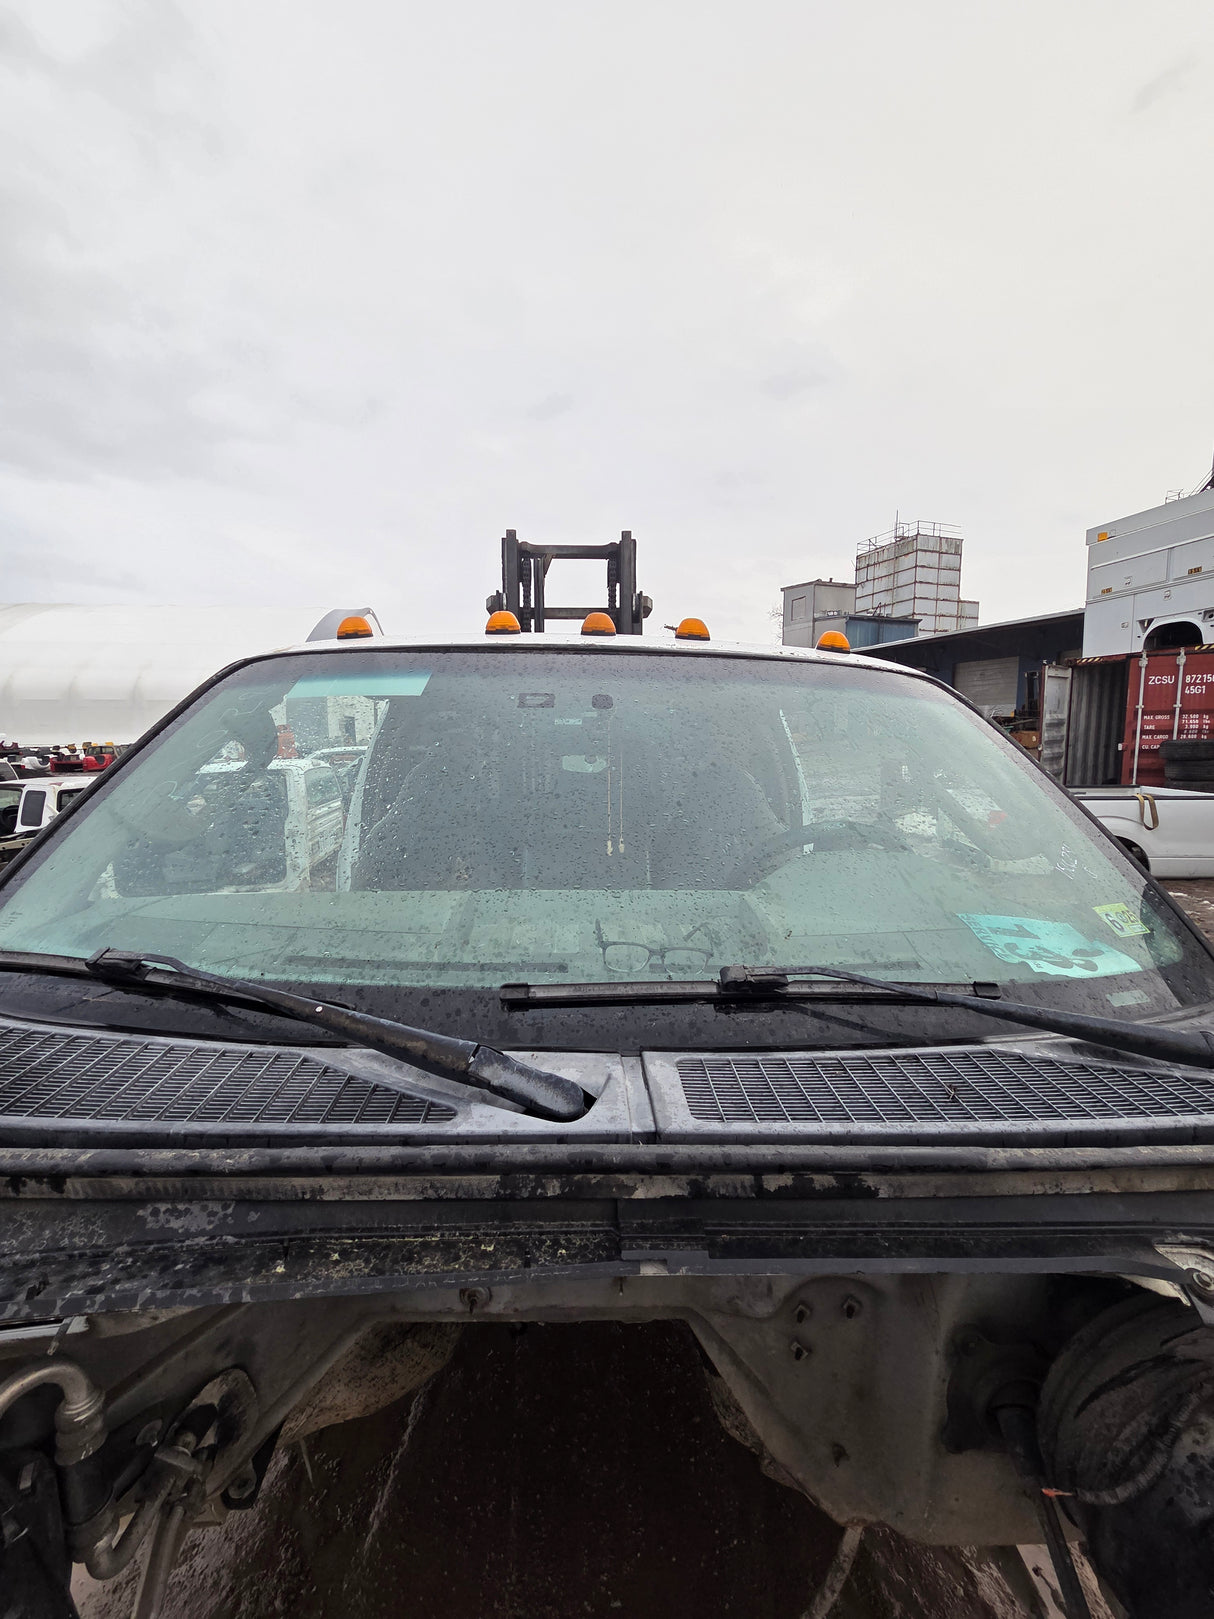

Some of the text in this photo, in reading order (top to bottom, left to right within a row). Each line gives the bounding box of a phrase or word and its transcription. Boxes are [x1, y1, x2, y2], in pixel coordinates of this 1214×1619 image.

[1148, 675, 1175, 685] ZCSU
[1185, 685, 1206, 694] 45G1
[1105, 913, 1125, 932] 6
